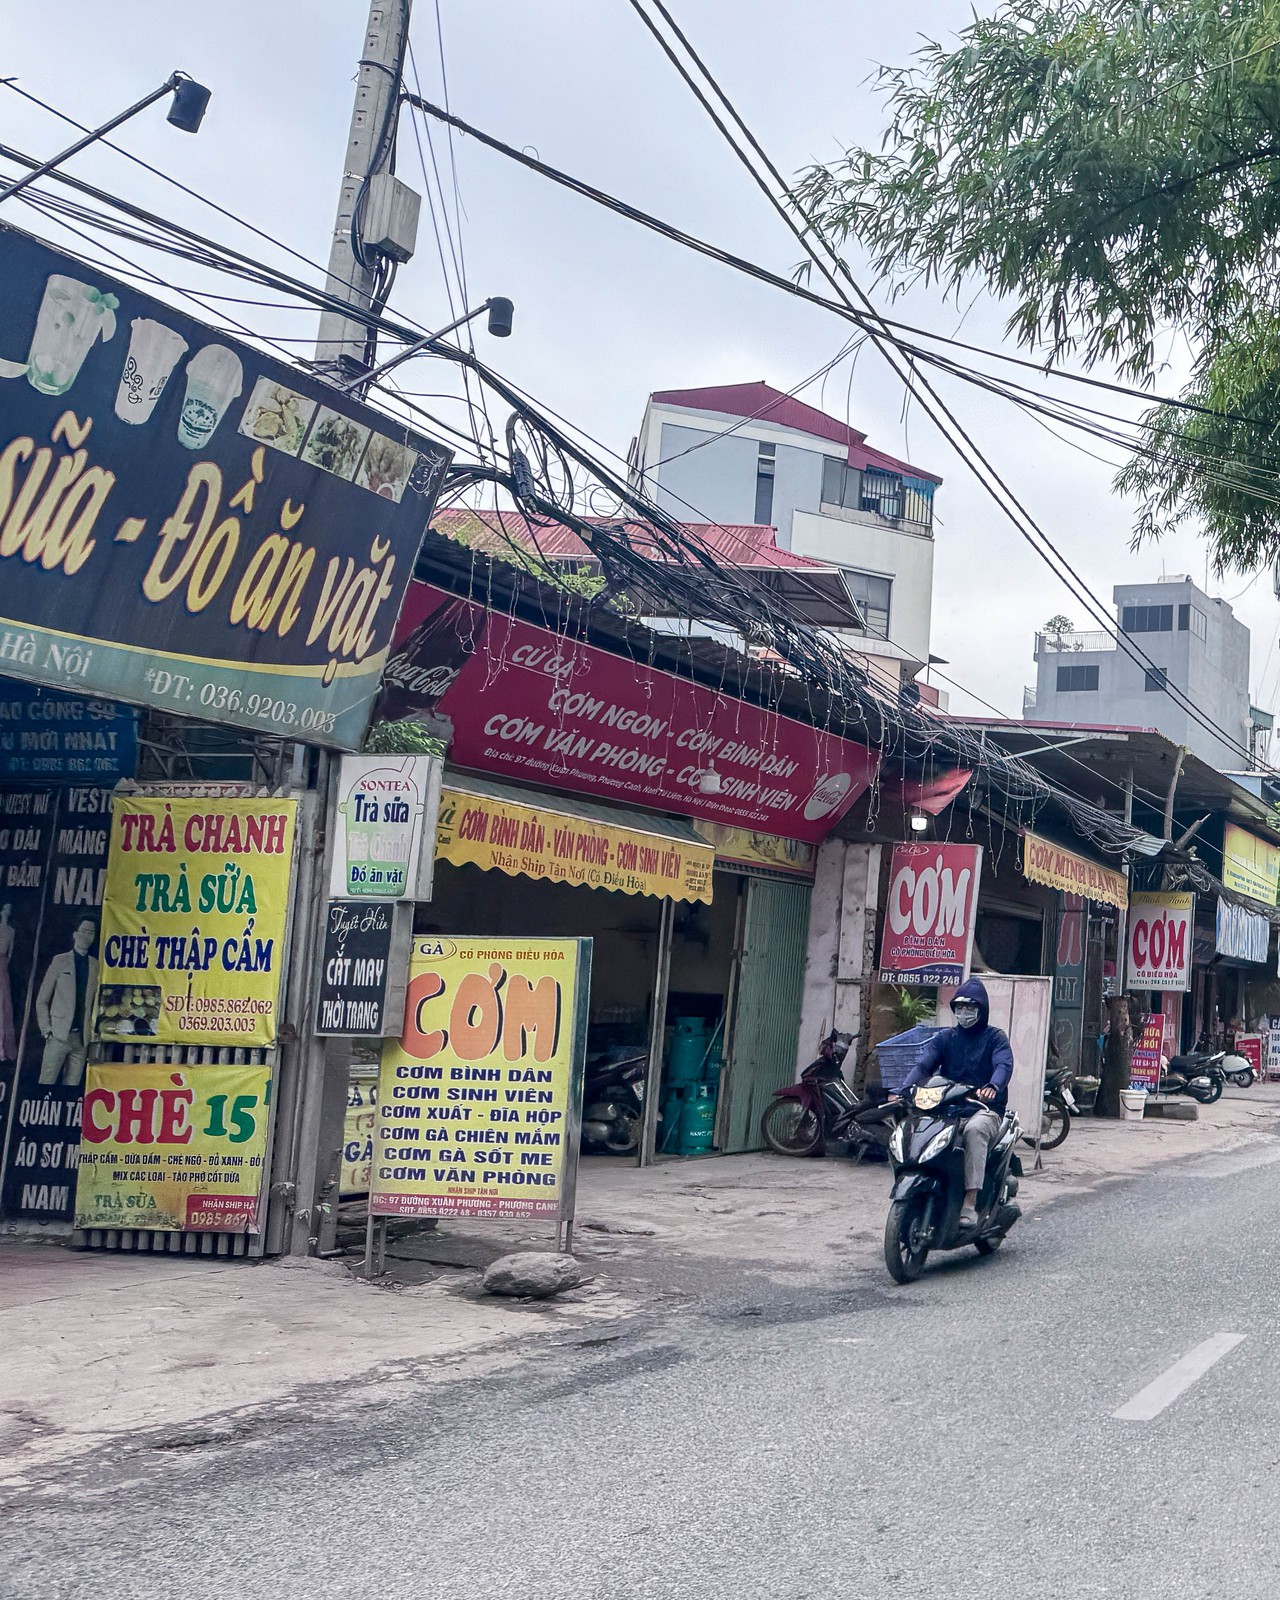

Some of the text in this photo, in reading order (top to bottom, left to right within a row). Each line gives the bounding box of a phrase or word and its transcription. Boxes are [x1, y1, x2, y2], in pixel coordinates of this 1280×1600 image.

[0, 411, 396, 688] sữa Đồ ăn vặt
[1, 631, 40, 665] Hà
[43, 638, 93, 689] Nội
[548, 688, 601, 720] CƠM
[603, 705, 668, 740] NGON
[717, 739, 765, 767] BÌNH
[759, 754, 800, 779] DÂN
[484, 712, 799, 812] CƠM VĂN PHÒNG SINH VIÊN
[360, 780, 411, 792] SONTEA
[354, 793, 410, 823] Trà sữa
[121, 802, 288, 855] TRÀ CHANH
[458, 806, 490, 844] CƠM
[488, 808, 521, 849] BÌNH
[520, 815, 546, 855] DÂN
[553, 823, 576, 861] VĂN
[574, 828, 610, 866] PHÒNG
[660, 845, 682, 880] VIÊN
[489, 850, 519, 870] Nhận
[520, 856, 546, 875] Ship
[135, 863, 258, 915] TRÀ SỮA
[370, 868, 404, 886] ăn vặt
[888, 854, 971, 938] CƠM
[105, 925, 150, 969] CHÈ
[155, 926, 218, 980] THẬP
[420, 941, 445, 955] GÀ
[1133, 910, 1187, 970] CƠM
[326, 941, 385, 988] CẮT MAY
[459, 948, 474, 960] CÓ
[477, 948, 513, 960] PHÒNG
[543, 949, 565, 961] HÒA
[897, 973, 921, 983] 0855
[922, 974, 941, 984] 922
[195, 998, 273, 1015] 0985.862.062
[321, 993, 380, 1030] THỜI TRANG
[400, 961, 562, 1063] CƠM
[178, 1015, 257, 1032] 0369.203.003
[396, 1065, 553, 1083] CƠM BÌNH DÂN
[392, 1085, 443, 1100] CƠM
[446, 1086, 498, 1101] SINH
[505, 1085, 554, 1103] VIÊN
[19, 1091, 62, 1128] QUẦN
[82, 1073, 258, 1145] CHÈ 15
[381, 1103, 563, 1126] CƠM XUẤT ĐĨA HỘP
[380, 1122, 561, 1146] CƠM GÀ CHIÊN MẮM
[15, 1135, 64, 1169] ÁO SƠ
[221, 1156, 244, 1167] XANH
[384, 1145, 554, 1166] CƠM GÀ SỐT ME
[378, 1166, 426, 1181] CƠM
[433, 1166, 476, 1183] VĂN
[482, 1167, 557, 1186] PHÒNG
[21, 1184, 70, 1211] NAM
[94, 1191, 123, 1208] TRÀ
[388, 1196, 400, 1204] 97
[431, 1196, 455, 1207] XUÂN
[456, 1199, 491, 1209] PHƯƠNG
[499, 1200, 534, 1210] PHƯƠNG
[190, 1211, 222, 1226] 0985
